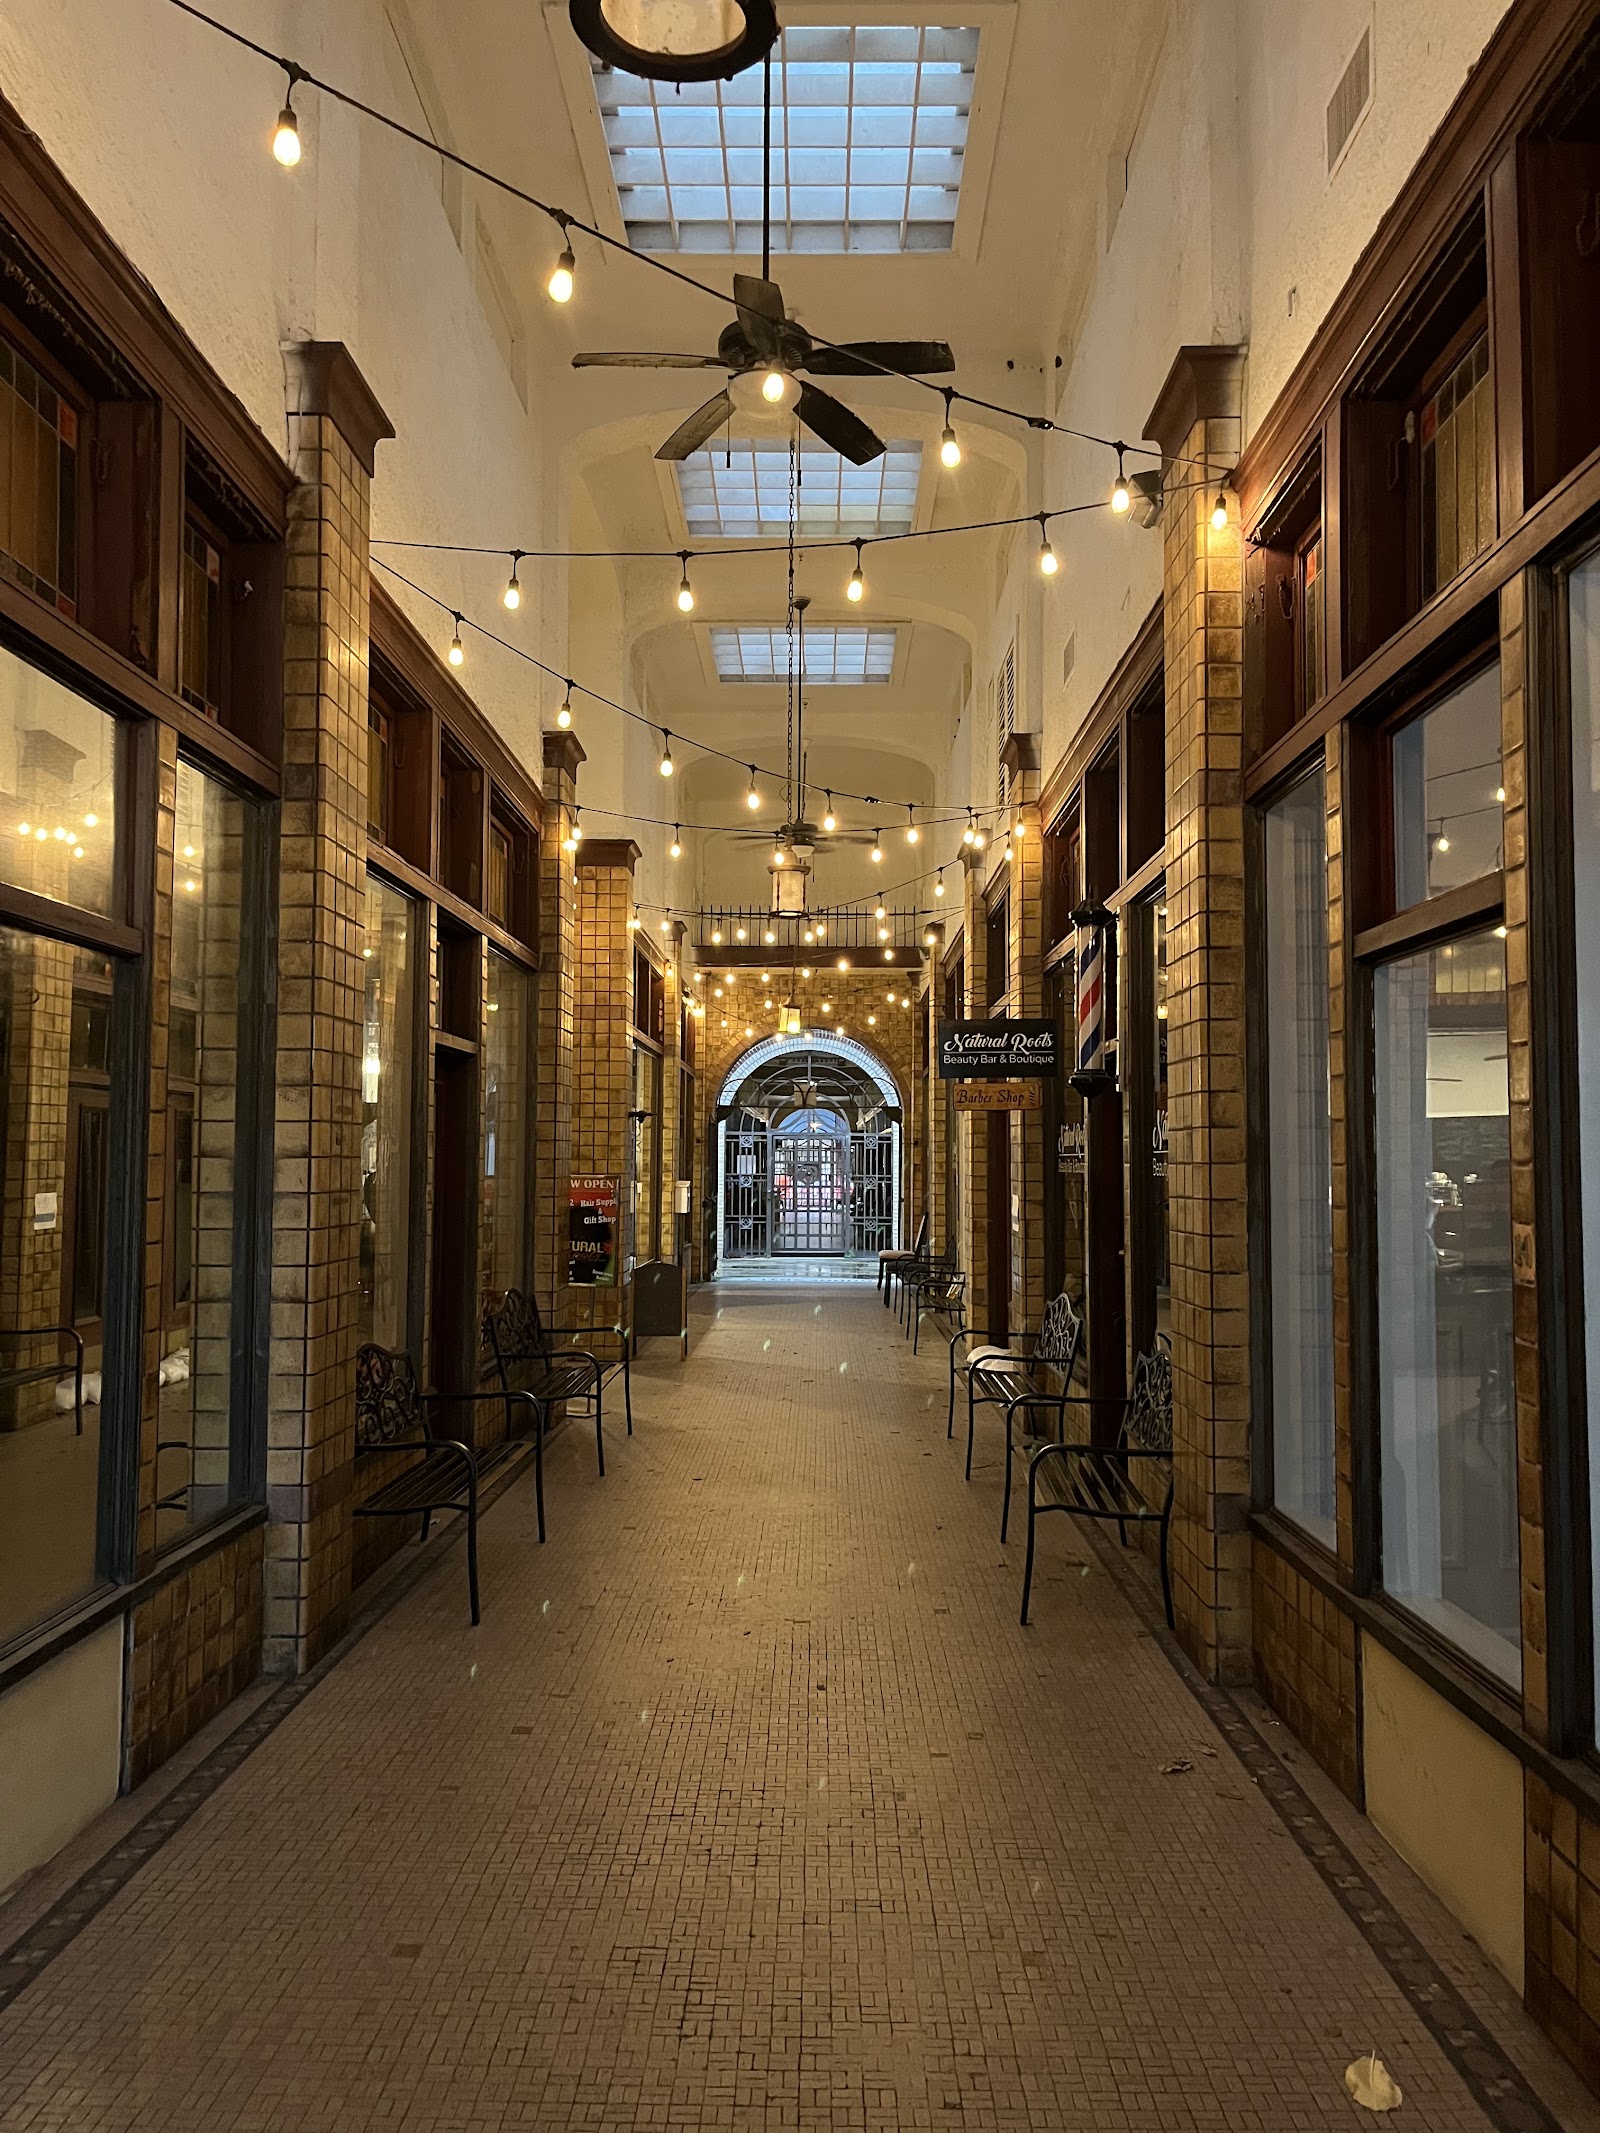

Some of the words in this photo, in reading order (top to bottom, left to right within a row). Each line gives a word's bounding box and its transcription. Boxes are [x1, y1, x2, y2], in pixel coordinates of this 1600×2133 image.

[943, 1032, 1008, 1052] Natural
[1011, 1032, 1054, 1055] Roots
[943, 1054, 979, 1066] Beauty
[980, 1055, 998, 1063] Bar
[999, 1055, 1008, 1063] &
[1009, 1054, 1055, 1065] Boutique
[956, 1089, 993, 1104] Barber
[997, 1089, 1024, 1106] Shop
[570, 1179, 581, 1189] W
[584, 1179, 614, 1189] OPEN
[580, 1199, 595, 1207] Hair
[596, 1198, 617, 1207] Suppl
[584, 1215, 597, 1224] Gift
[598, 1215, 616, 1224] Shop
[570, 1240, 604, 1253] URAL
